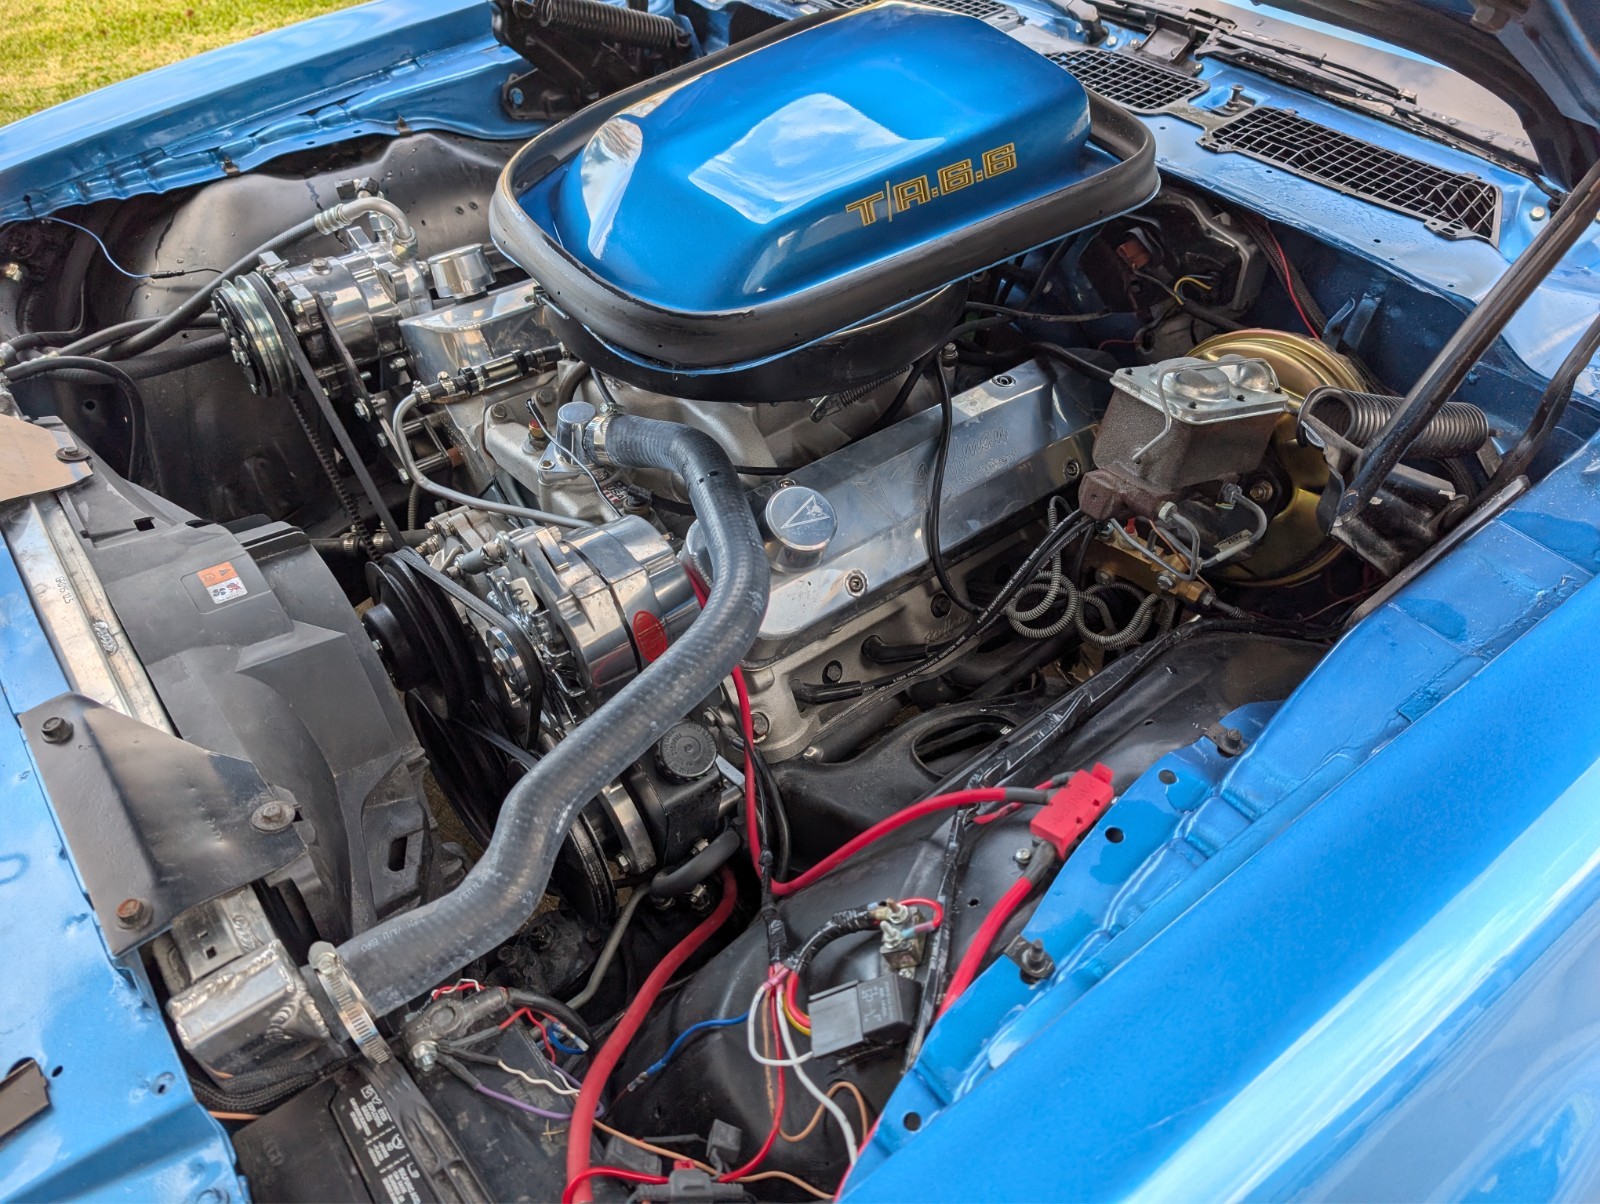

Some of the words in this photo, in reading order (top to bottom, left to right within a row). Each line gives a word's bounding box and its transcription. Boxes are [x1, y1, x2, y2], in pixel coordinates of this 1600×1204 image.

[959, 448, 1022, 485] Equipment
[988, 580, 1014, 612] PERFORMANCE
[1013, 560, 1030, 580] IGNITION
[1029, 548, 1039, 560] WIRE
[907, 657, 939, 677] PERFORMANCE
[938, 644, 956, 659] IGNITION
[956, 635, 966, 647] WIRE
